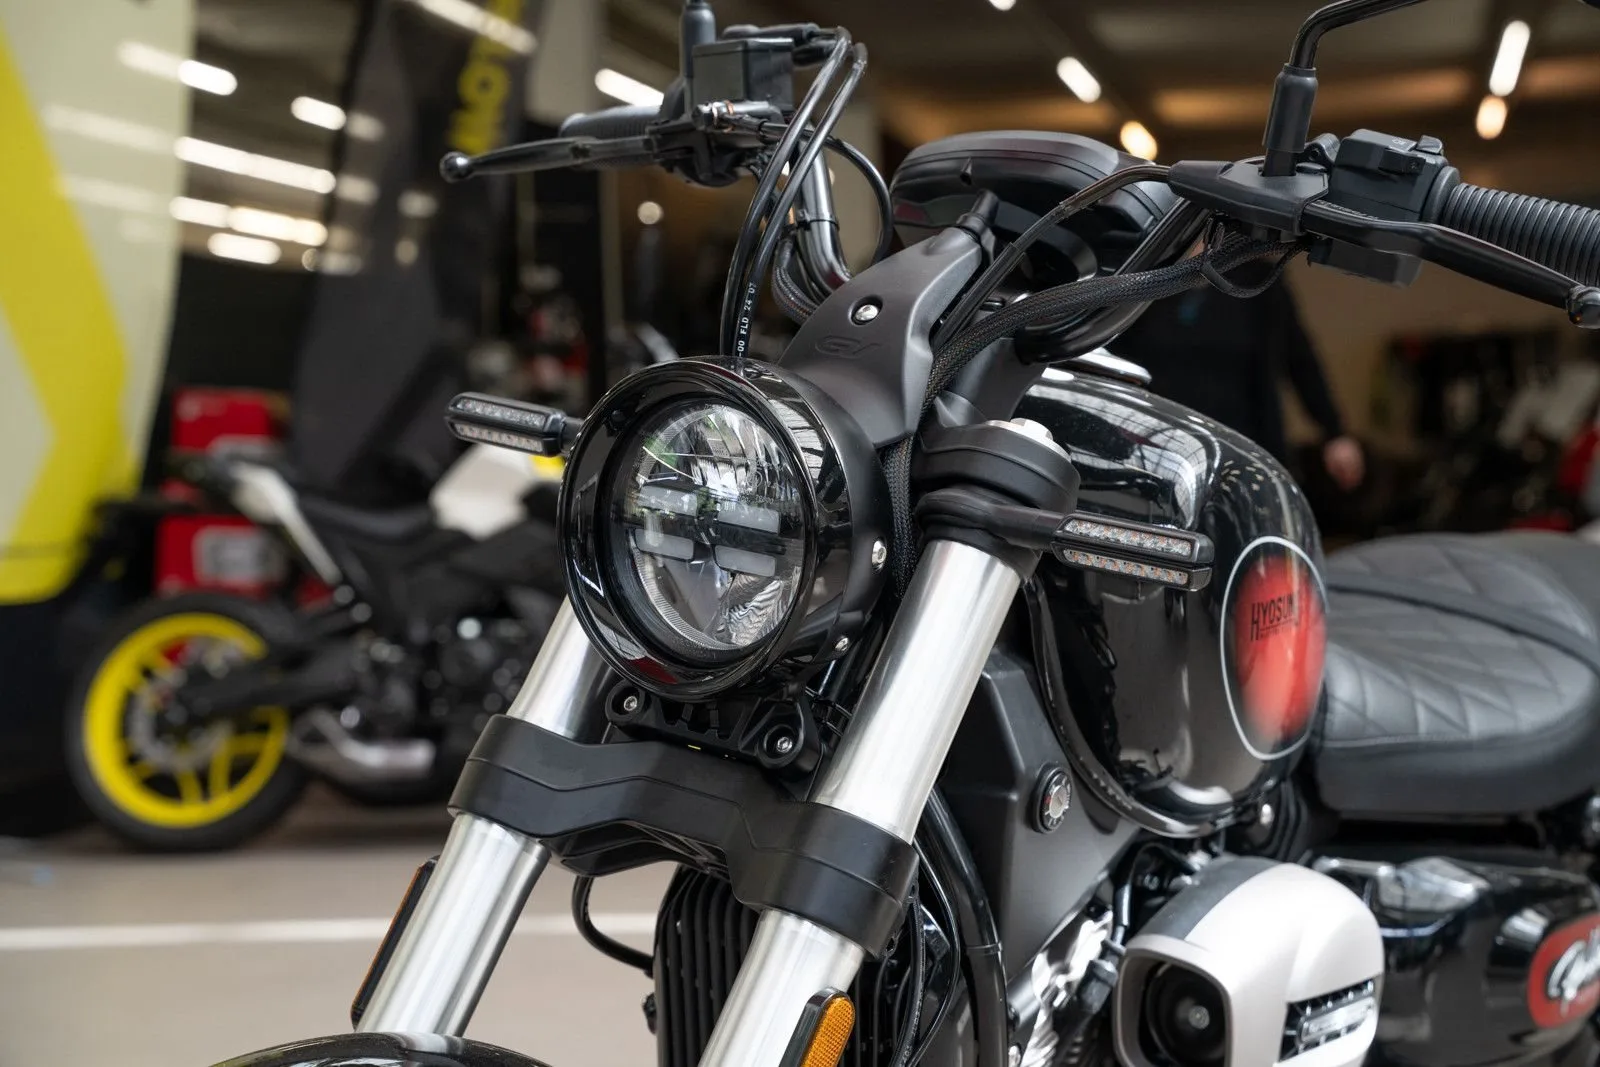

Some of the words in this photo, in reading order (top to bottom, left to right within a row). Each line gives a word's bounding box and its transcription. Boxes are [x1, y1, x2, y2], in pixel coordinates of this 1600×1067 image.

[744, 300, 752, 311] 24
[740, 317, 749, 335] FLD
[1250, 593, 1299, 641] HYOSUN
